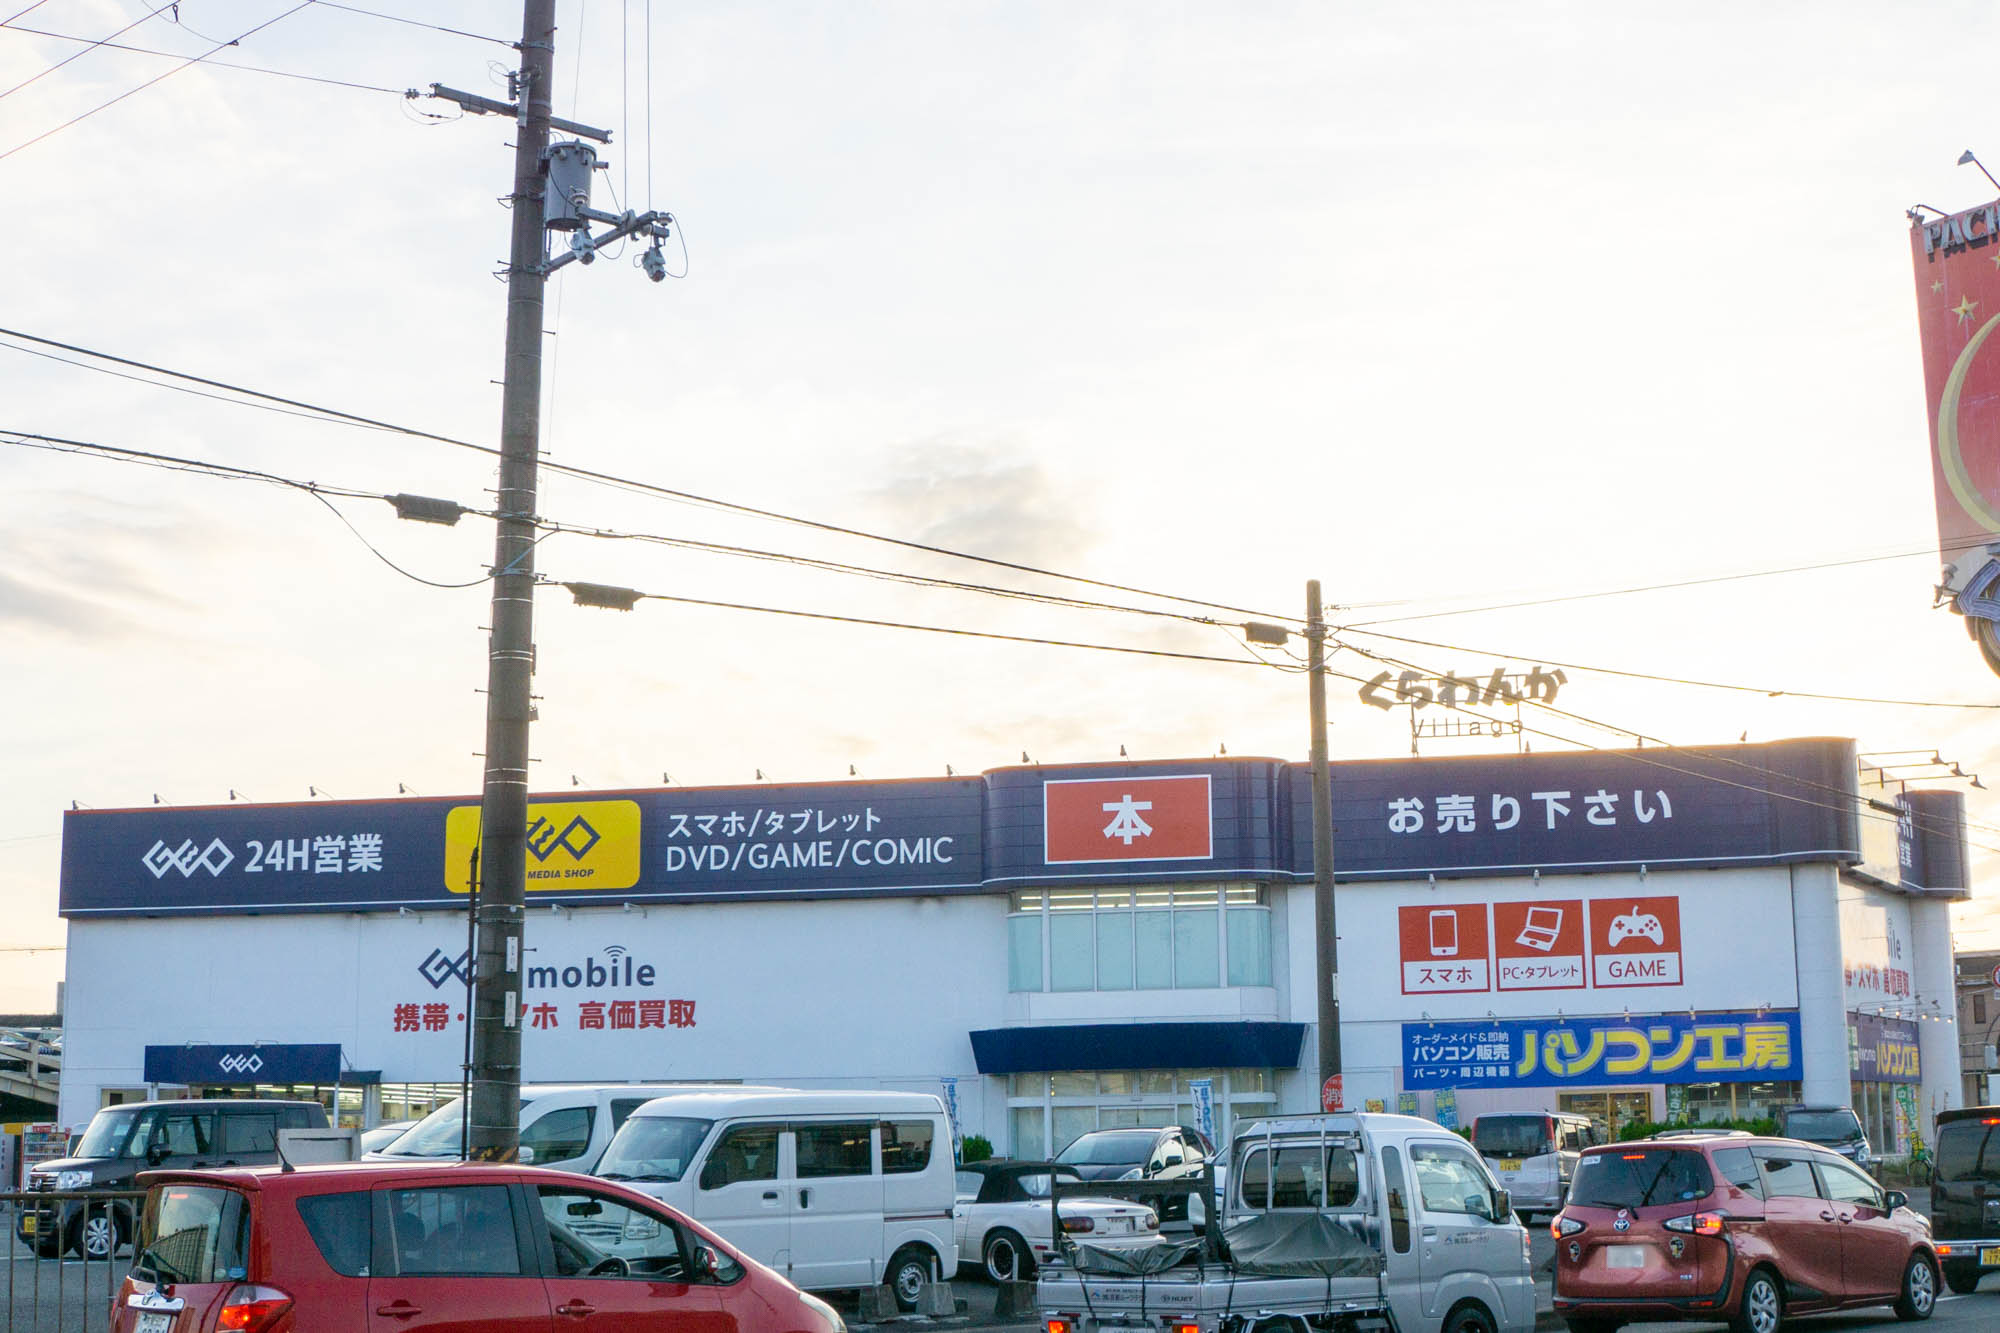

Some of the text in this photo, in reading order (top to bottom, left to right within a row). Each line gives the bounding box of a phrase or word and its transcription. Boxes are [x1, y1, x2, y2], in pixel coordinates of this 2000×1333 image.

[1358, 666, 1568, 712] くらわんか
[668, 808, 881, 838] スマホ/タブレット
[1102, 794, 1153, 845] 本
[1388, 789, 1672, 834] お売り下さい
[142, 833, 383, 879] GEO 24H営業
[666, 836, 953, 872] DVD/GAME/COMIC
[527, 868, 594, 880] MEDIA SHOP
[528, 956, 656, 988] mobile
[1419, 966, 1473, 985] スマホ
[1609, 960, 1667, 978] GAME
[578, 999, 697, 1030] 高価買取
[219, 1053, 263, 1073] GEO
[1412, 1044, 1510, 1061] パソコン販売
[1516, 1022, 1791, 1078] パソコン工房
